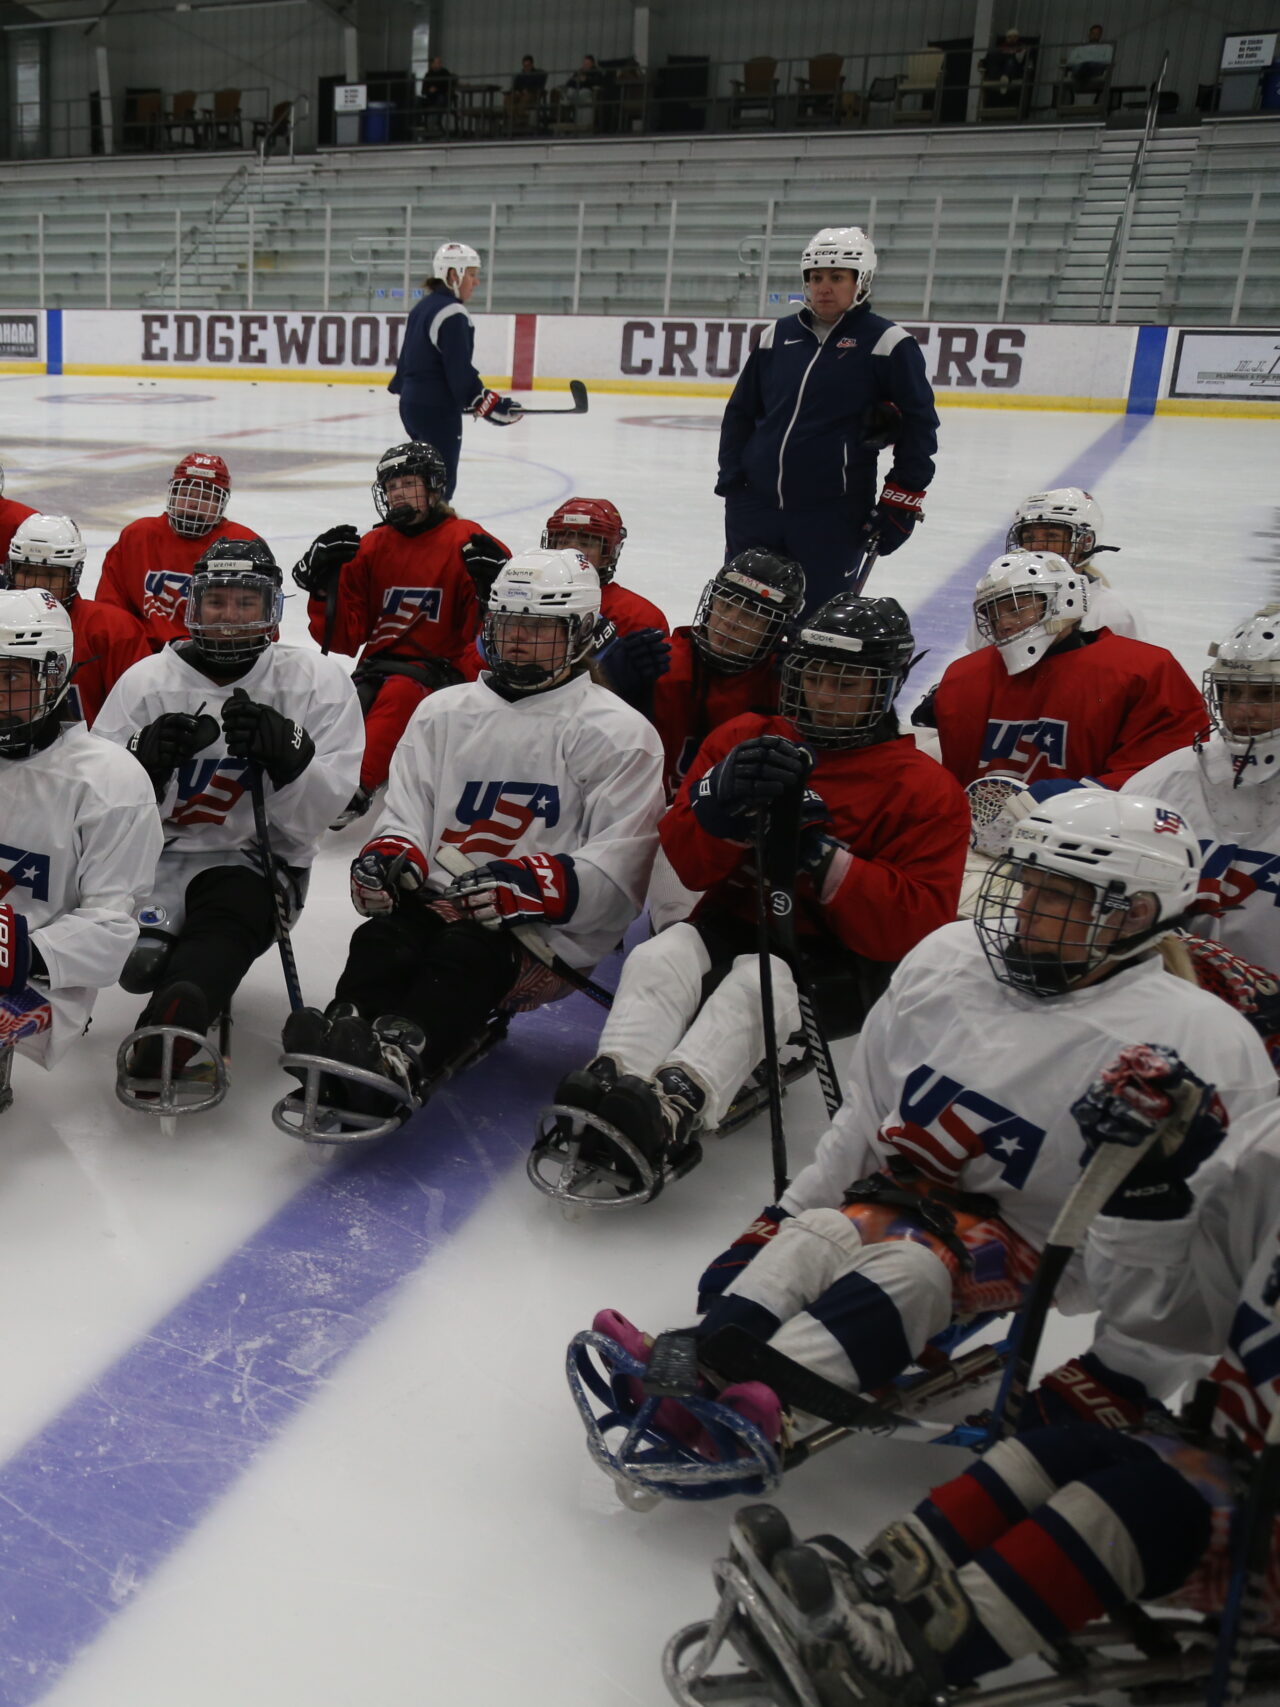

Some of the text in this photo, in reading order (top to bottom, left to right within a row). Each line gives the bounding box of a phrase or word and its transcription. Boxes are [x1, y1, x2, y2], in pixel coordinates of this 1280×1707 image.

[382, 587, 442, 622] USA
[982, 717, 1068, 768] USA
[456, 780, 560, 839] USA
[798, 992, 840, 1111] WARRI
[900, 1063, 1048, 1190] USA
